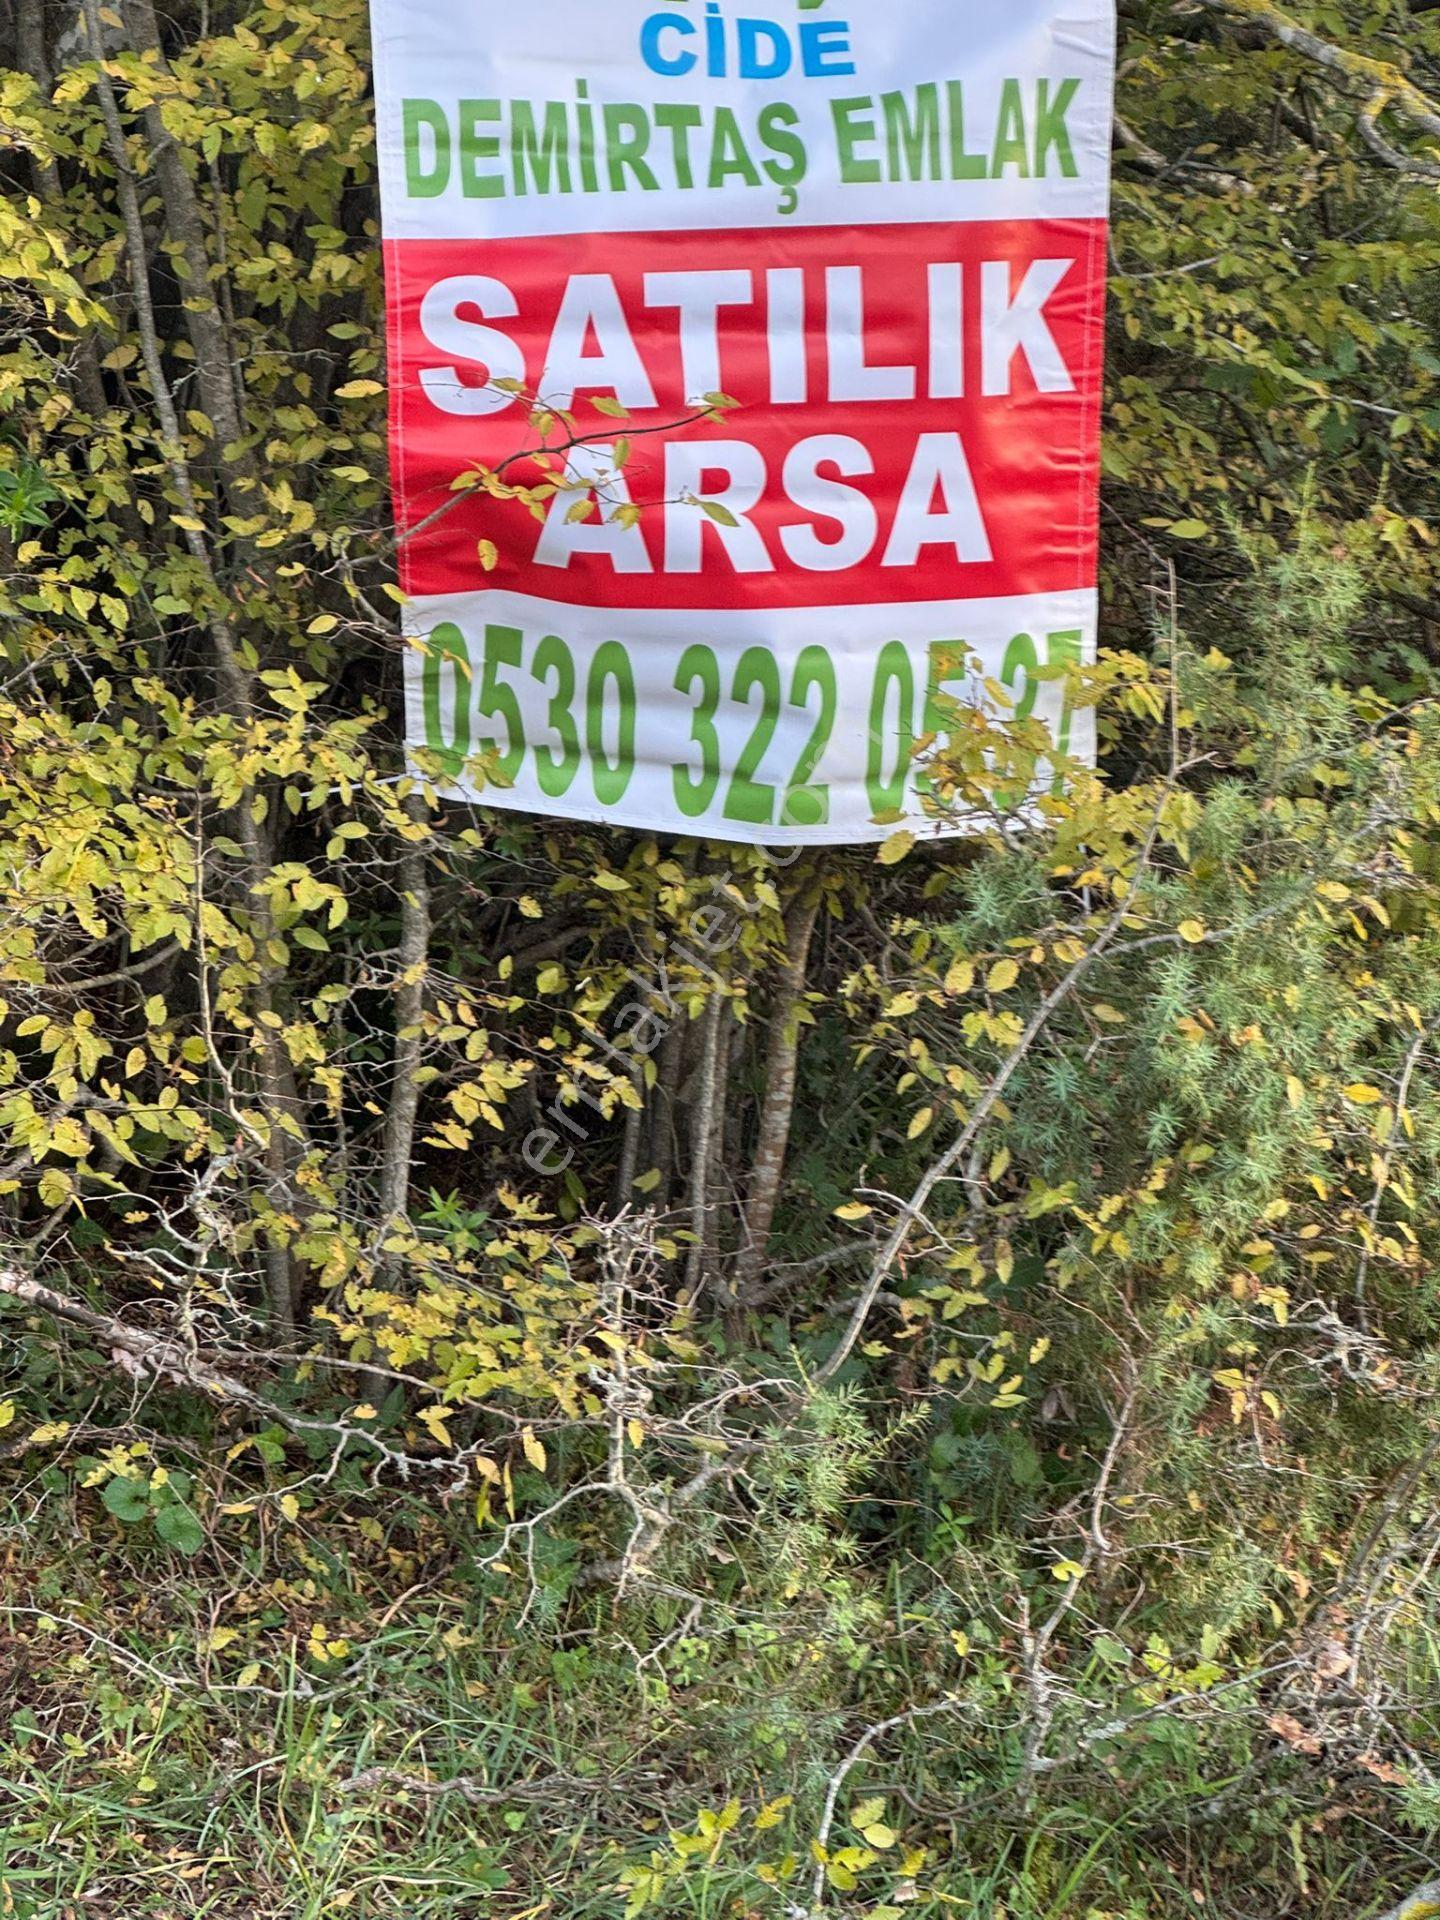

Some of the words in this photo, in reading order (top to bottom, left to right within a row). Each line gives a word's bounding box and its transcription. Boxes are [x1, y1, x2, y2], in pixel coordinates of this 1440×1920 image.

[640, 2, 857, 80] CİDE
[401, 78, 808, 215] DEMİRTAŞ
[831, 76, 1082, 183] EMLAK
[417, 257, 1076, 416] SATILIK
[532, 431, 993, 574] ARSA
[421, 621, 637, 806] 0530
[672, 643, 838, 828] 322
